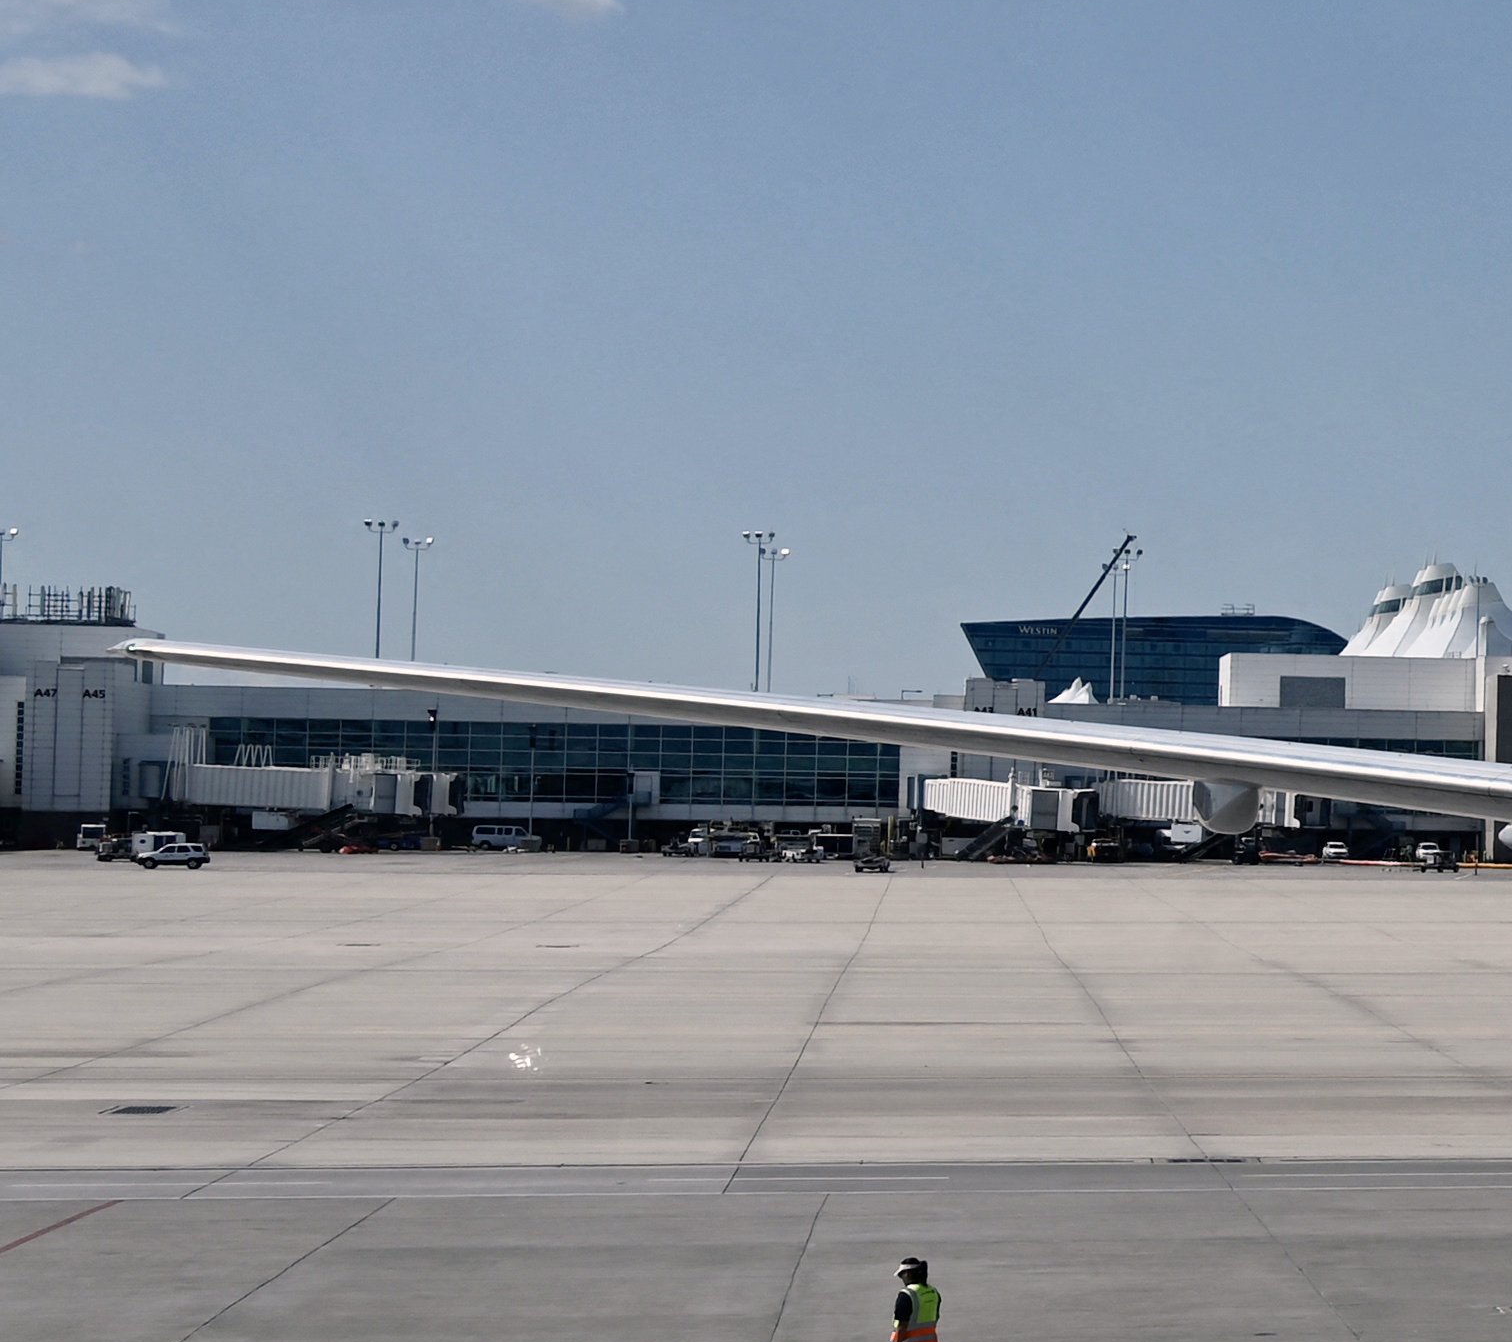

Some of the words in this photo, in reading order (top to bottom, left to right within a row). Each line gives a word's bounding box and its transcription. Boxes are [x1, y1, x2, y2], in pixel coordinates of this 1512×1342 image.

[1018, 625, 1057, 635] WESTIN
[34, 688, 58, 698] A47
[82, 689, 106, 699] A45
[1016, 707, 1037, 717] A41
